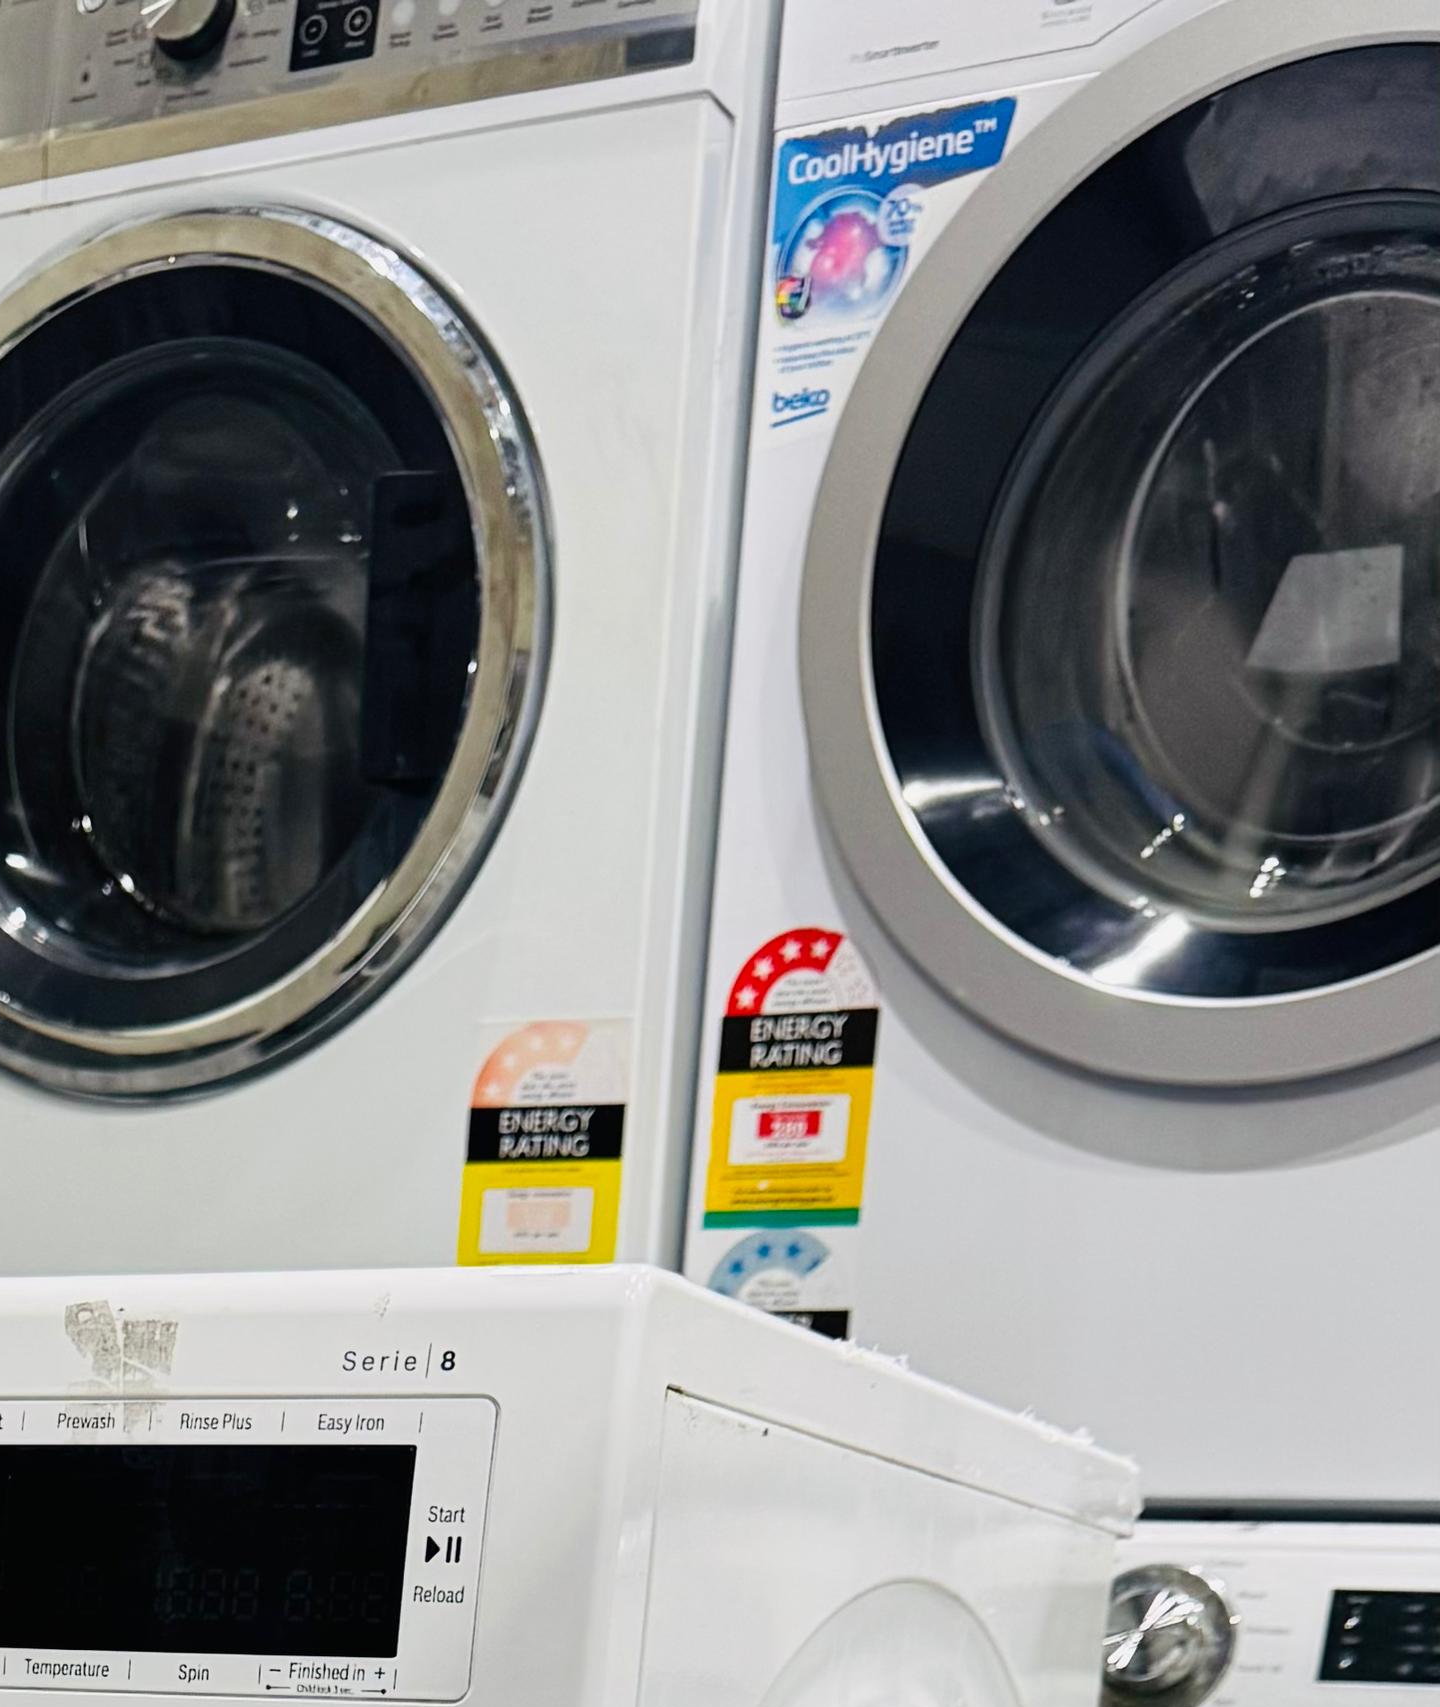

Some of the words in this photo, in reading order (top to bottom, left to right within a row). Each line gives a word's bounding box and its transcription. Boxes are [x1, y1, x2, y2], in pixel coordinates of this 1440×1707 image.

[749, 1013, 850, 1043] ENERGY
[749, 1040, 844, 1069] RATING
[497, 1108, 596, 1134] ENERGY
[498, 1134, 591, 1159] RATING
[342, 1350, 417, 1373] Serie
[440, 1350, 457, 1372] 8
[56, 1413, 116, 1430] Prewash
[179, 1412, 219, 1430] Rinse
[222, 1413, 253, 1430] Plus
[317, 1413, 350, 1433] Easy
[352, 1413, 385, 1431] Iron
[428, 1505, 465, 1522] Start
[413, 1586, 465, 1604] Reload
[25, 1658, 110, 1679] Temperature
[178, 1663, 210, 1683] Spin
[289, 1662, 350, 1681] Finished
[352, 1664, 365, 1681] in
